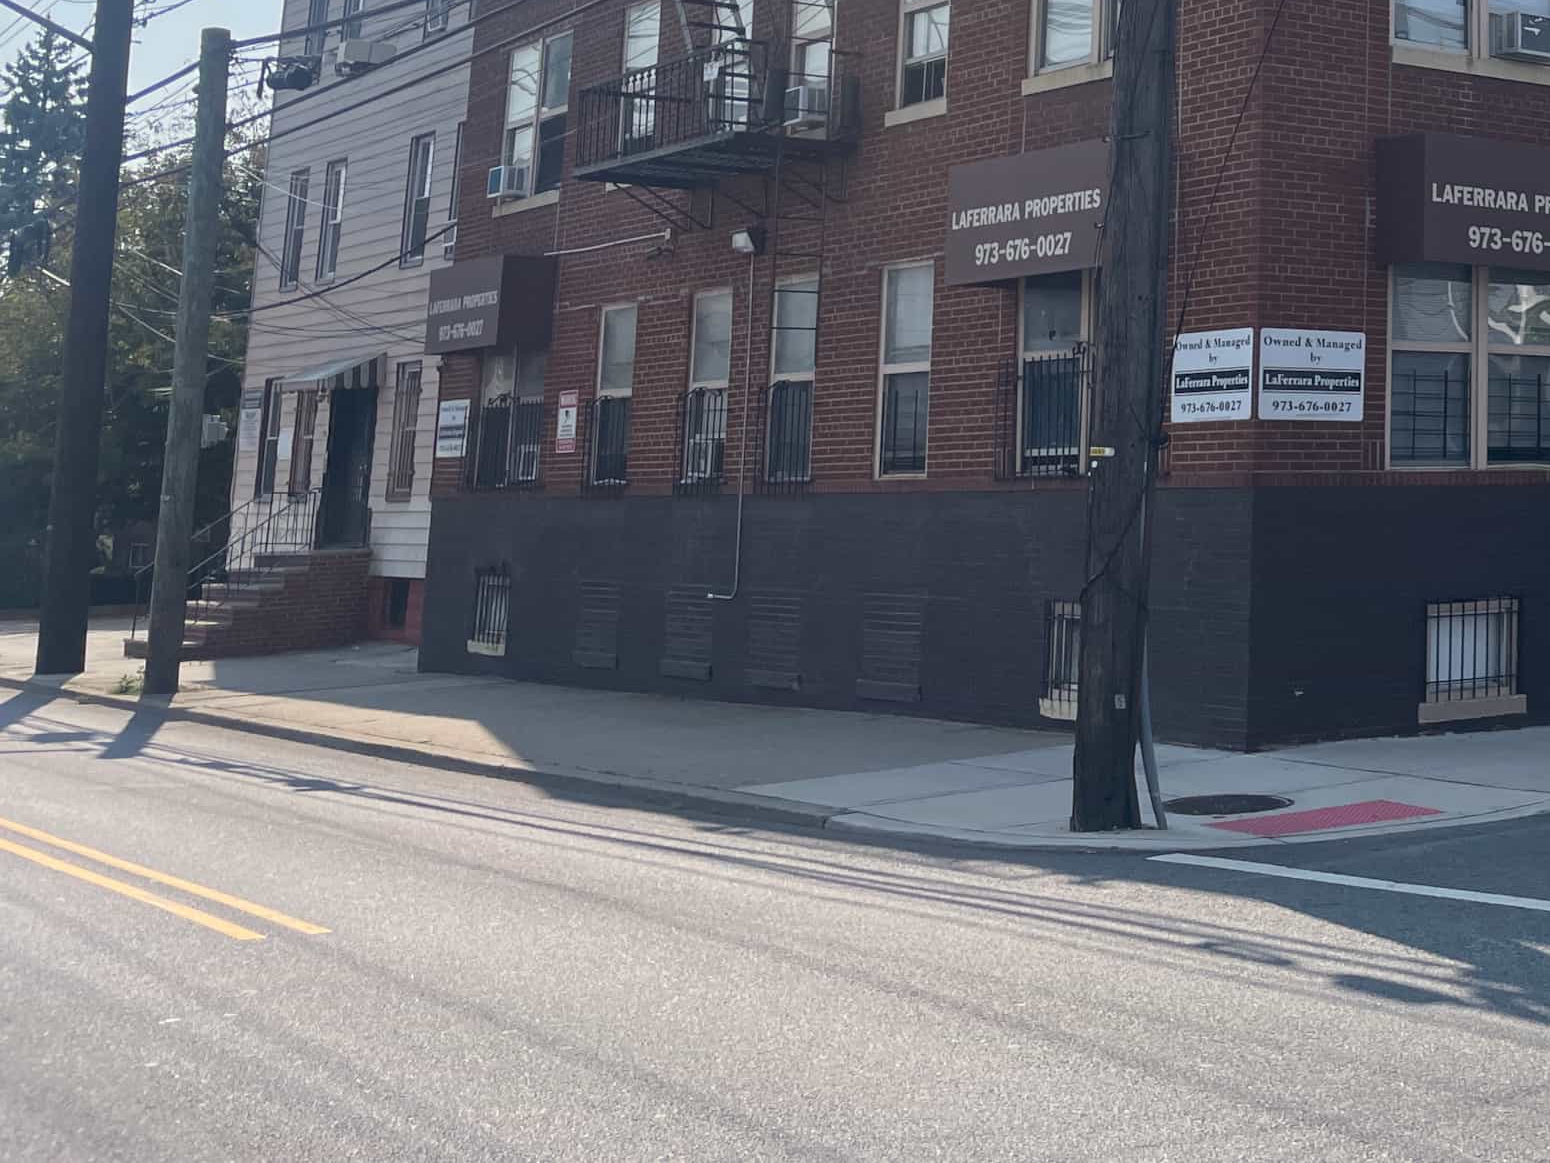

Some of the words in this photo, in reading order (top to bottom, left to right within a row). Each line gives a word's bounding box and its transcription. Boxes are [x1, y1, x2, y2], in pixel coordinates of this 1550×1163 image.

[1432, 182, 1529, 212] LAFERRARA
[951, 202, 1021, 230] LAFERRARA
[1024, 188, 1101, 219] PROPERTIES
[975, 232, 1072, 265] 973-676-0027
[1205, 338, 1211, 349] &
[1214, 334, 1250, 350] Managed
[1263, 336, 1301, 347] Owned
[1304, 337, 1313, 348] &
[1317, 337, 1362, 352] Managed
[1208, 352, 1217, 364] by
[1310, 352, 1321, 366] by
[1176, 376, 1211, 389] LaFerrara
[1212, 373, 1248, 389] Properties
[1265, 373, 1313, 386] LaFerrara
[1314, 374, 1360, 390] Properties
[1181, 400, 1242, 413] 973-676-0027
[1272, 400, 1352, 412] 973-676-0027
